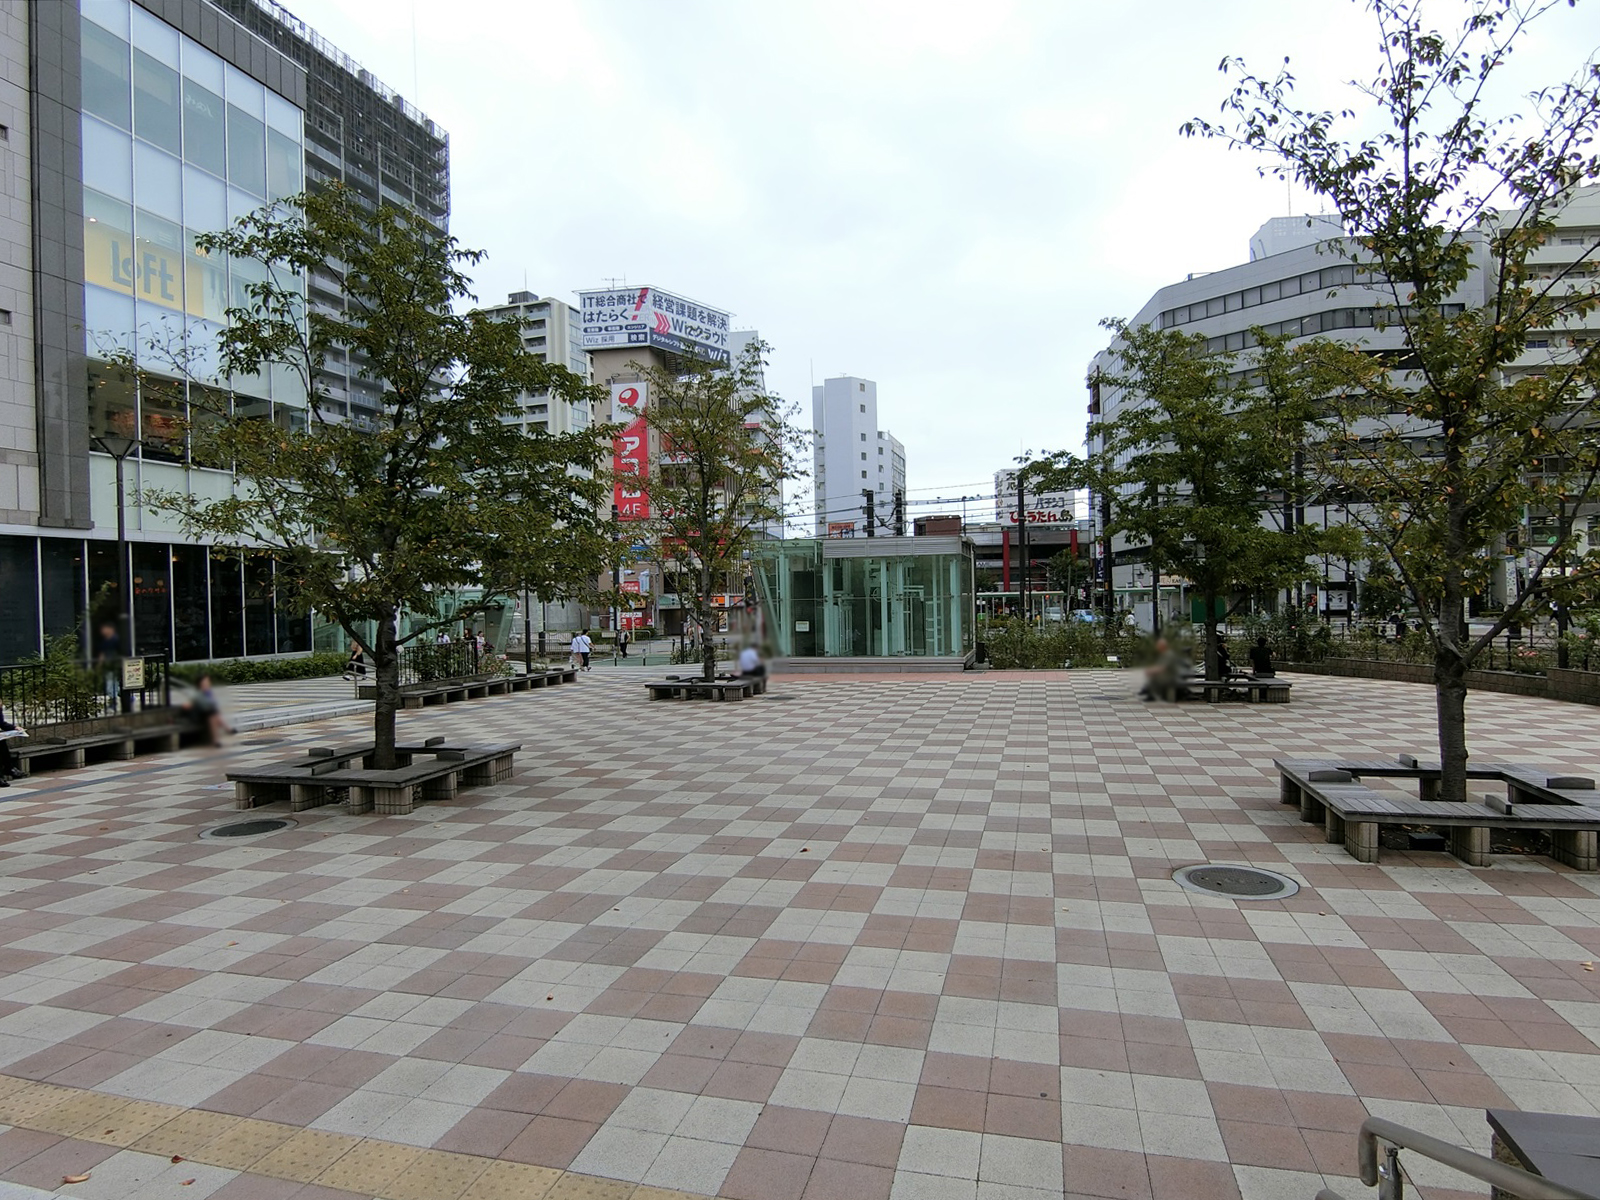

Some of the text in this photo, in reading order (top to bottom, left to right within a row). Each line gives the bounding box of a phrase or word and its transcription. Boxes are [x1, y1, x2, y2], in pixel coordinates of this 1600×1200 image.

[652, 293, 728, 332] 経営課題を解決
[630, 334, 645, 342] 検索
[622, 503, 642, 515] 4F
[1035, 497, 1065, 509] パチンコ
[1009, 508, 1074, 523] ひうたん島
